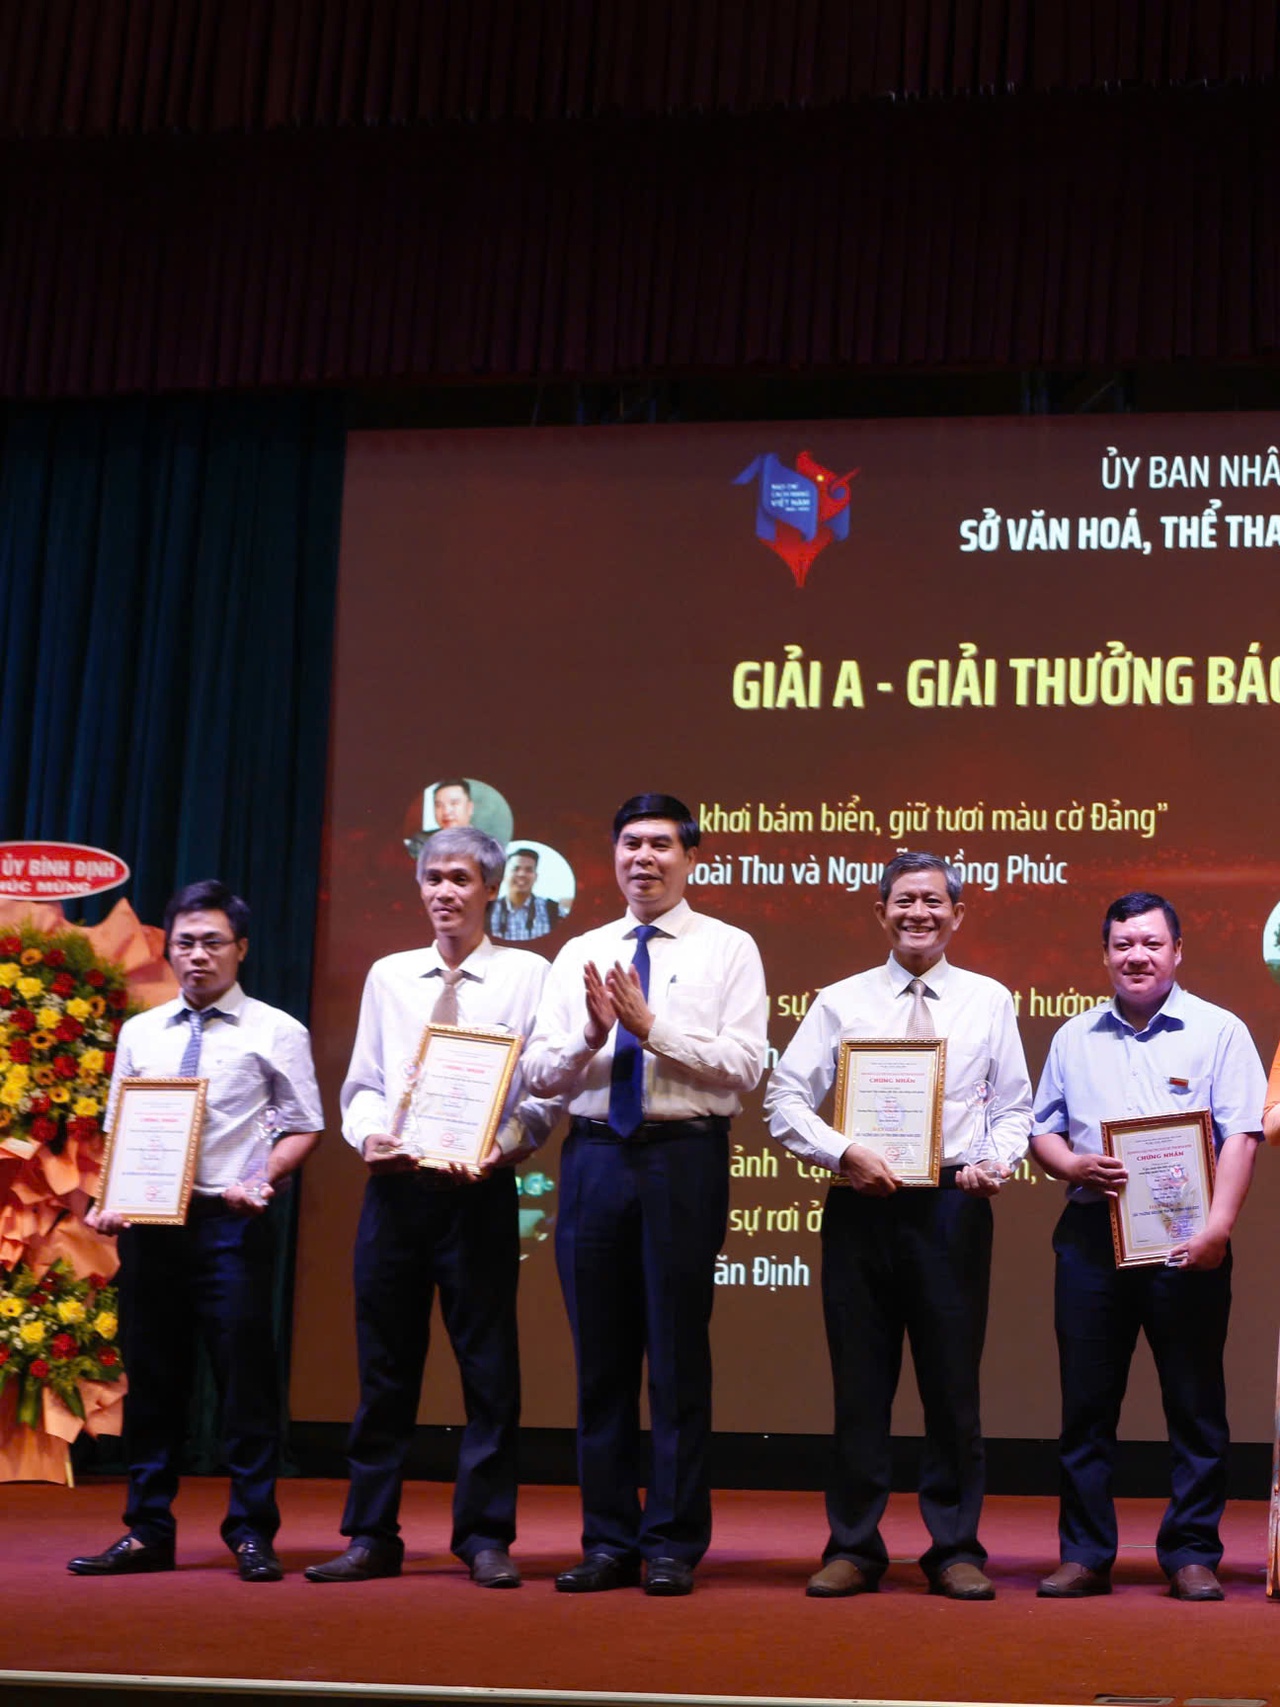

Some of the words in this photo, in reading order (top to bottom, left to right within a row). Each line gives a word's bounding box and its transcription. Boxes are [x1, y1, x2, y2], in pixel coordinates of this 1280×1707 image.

[1101, 446, 1141, 490] ỦY
[1148, 455, 1210, 489] BAN
[959, 507, 1002, 552] SỞ
[1006, 509, 1070, 551] VĂN
[1077, 507, 1152, 555] HOÁ,
[1159, 498, 1223, 549] THỂ
[732, 644, 822, 710] GIẢI
[832, 660, 865, 708] A
[876, 682, 893, 692] -
[906, 642, 997, 708] GIẢI
[1008, 640, 1194, 707] THƯỞNG
[699, 802, 751, 833] khơi
[758, 802, 814, 833] bám
[820, 794, 881, 836] biển,
[889, 801, 931, 840] giữ
[935, 801, 984, 832] tươi
[991, 801, 1049, 832] màu
[1055, 800, 1085, 832] cờ
[1089, 798, 1168, 839] Đảng”
[0, 879, 33, 893] HÚC
[36, 880, 92, 893] MỪNG
[28, 855, 71, 878] BÌNH
[74, 859, 116, 881] ĐỊNH
[688, 854, 733, 886] oài
[738, 854, 785, 885] Thu
[790, 854, 821, 885] và
[944, 848, 999, 892] ồng
[1006, 853, 1068, 885] Phúc
[777, 992, 811, 1022] sự
[729, 1144, 778, 1178] ảnh
[729, 1206, 762, 1237] sự
[766, 1201, 799, 1232] rơi
[713, 1253, 746, 1286] ăn
[751, 1255, 810, 1292] Định
